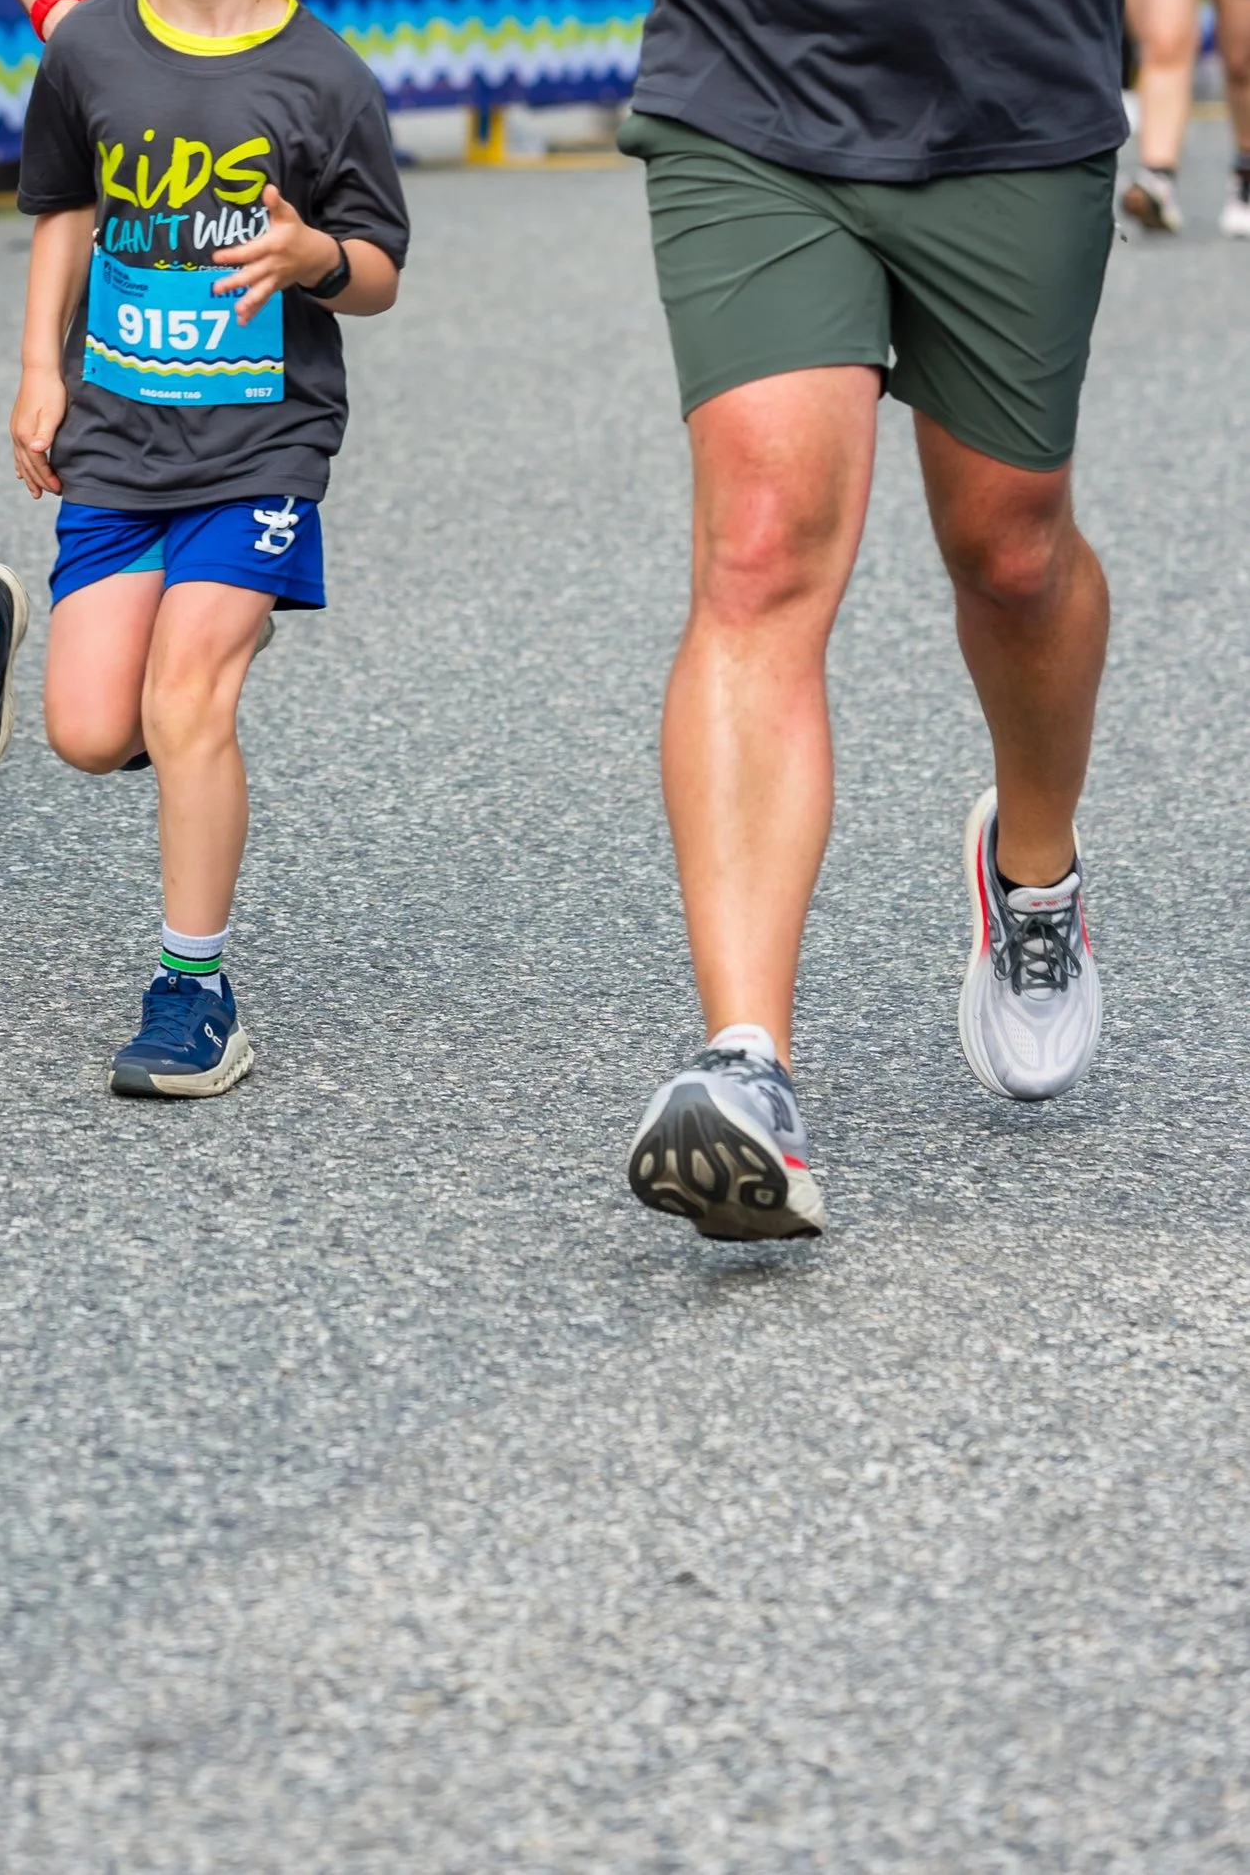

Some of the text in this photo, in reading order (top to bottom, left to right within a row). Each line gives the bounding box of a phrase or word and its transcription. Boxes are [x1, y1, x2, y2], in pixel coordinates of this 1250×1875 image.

[105, 211, 191, 255] CAN'T
[116, 303, 232, 352] 9157
[244, 387, 274, 398] 9157
